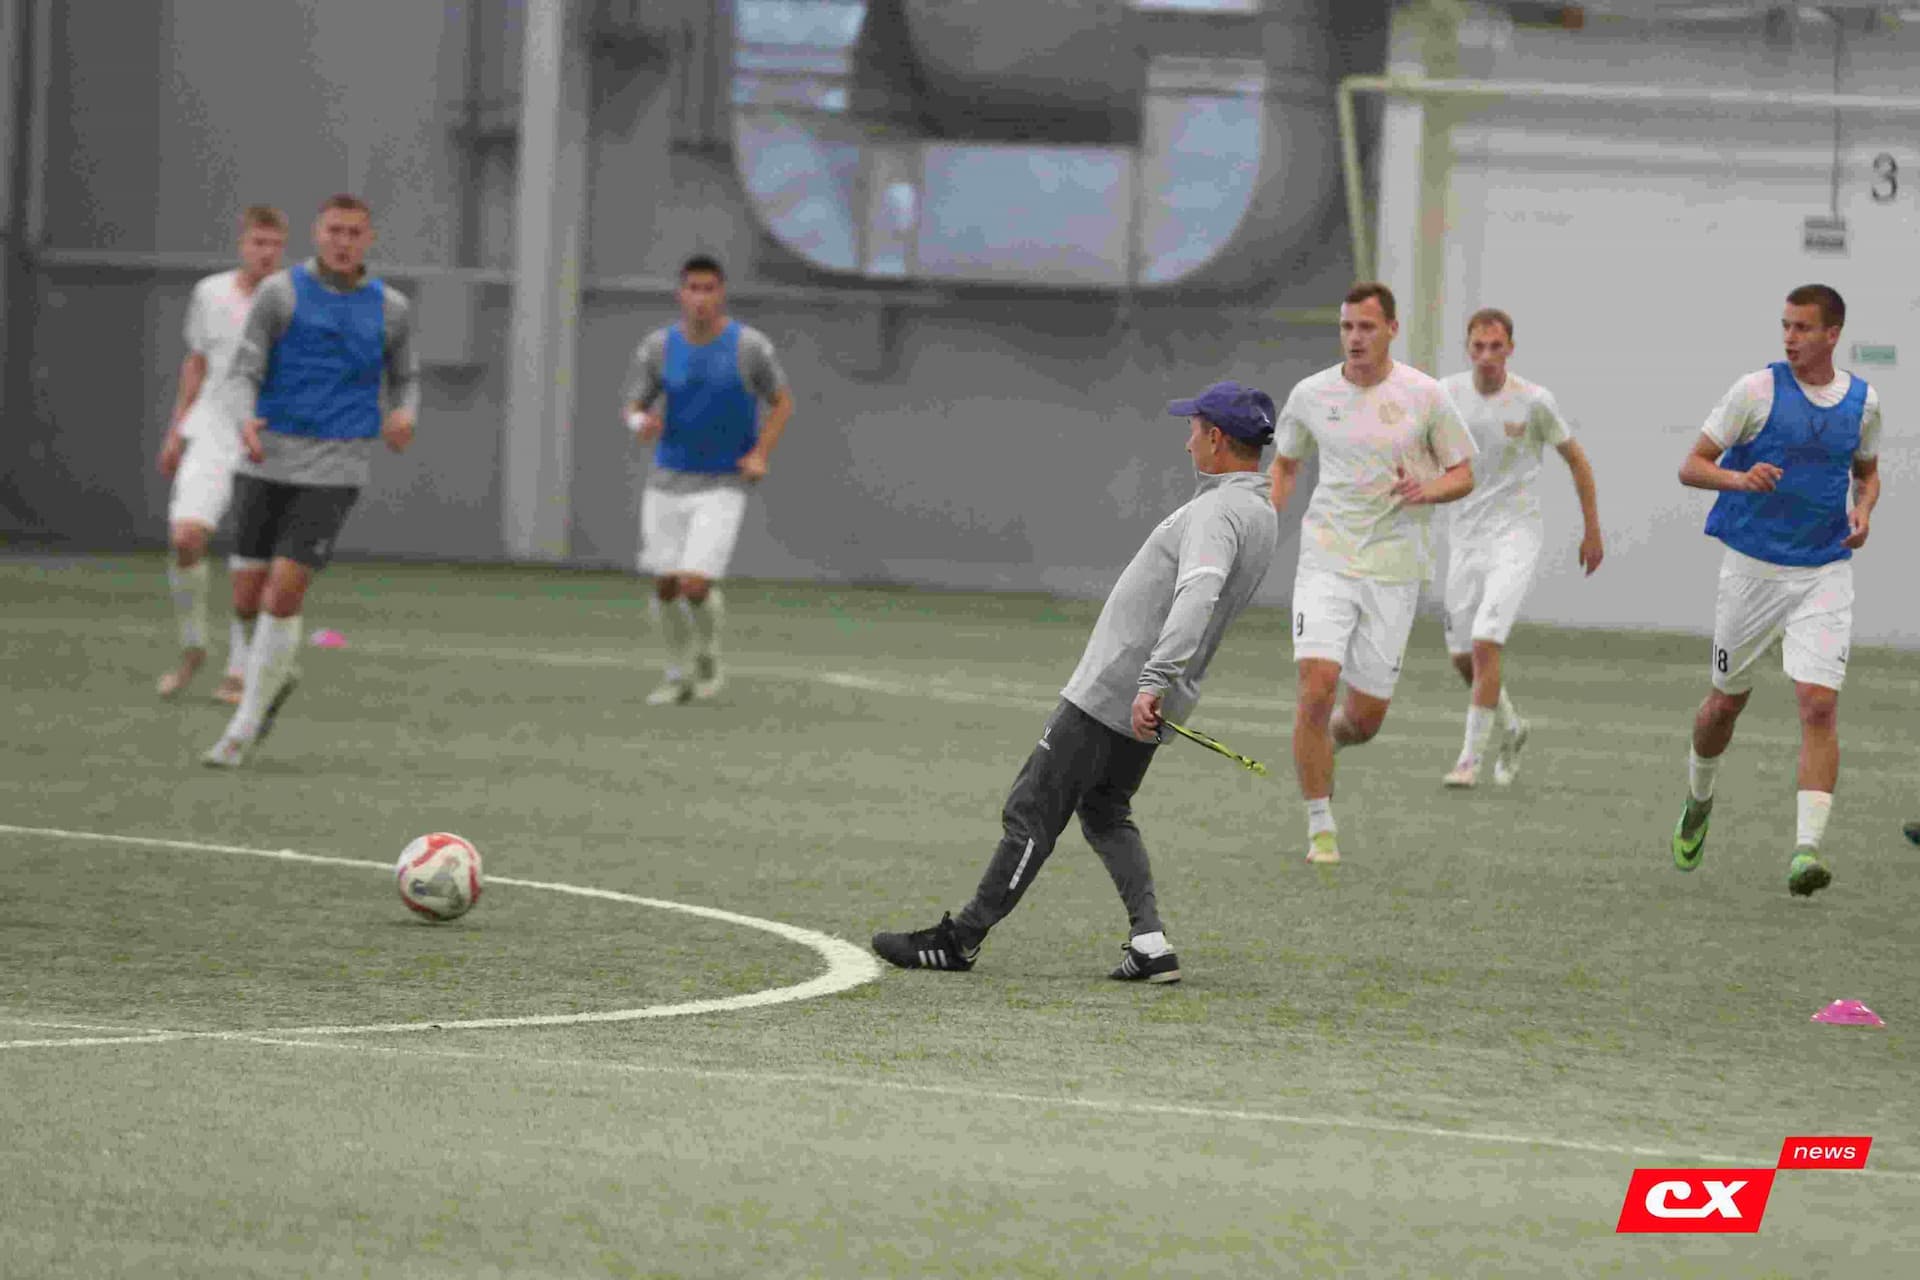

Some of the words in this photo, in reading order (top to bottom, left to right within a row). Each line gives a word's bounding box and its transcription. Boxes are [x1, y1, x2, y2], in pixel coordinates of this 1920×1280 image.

[1871, 152, 1898, 205] 3
[1296, 612, 1304, 637] 9
[1714, 644, 1728, 673] 18
